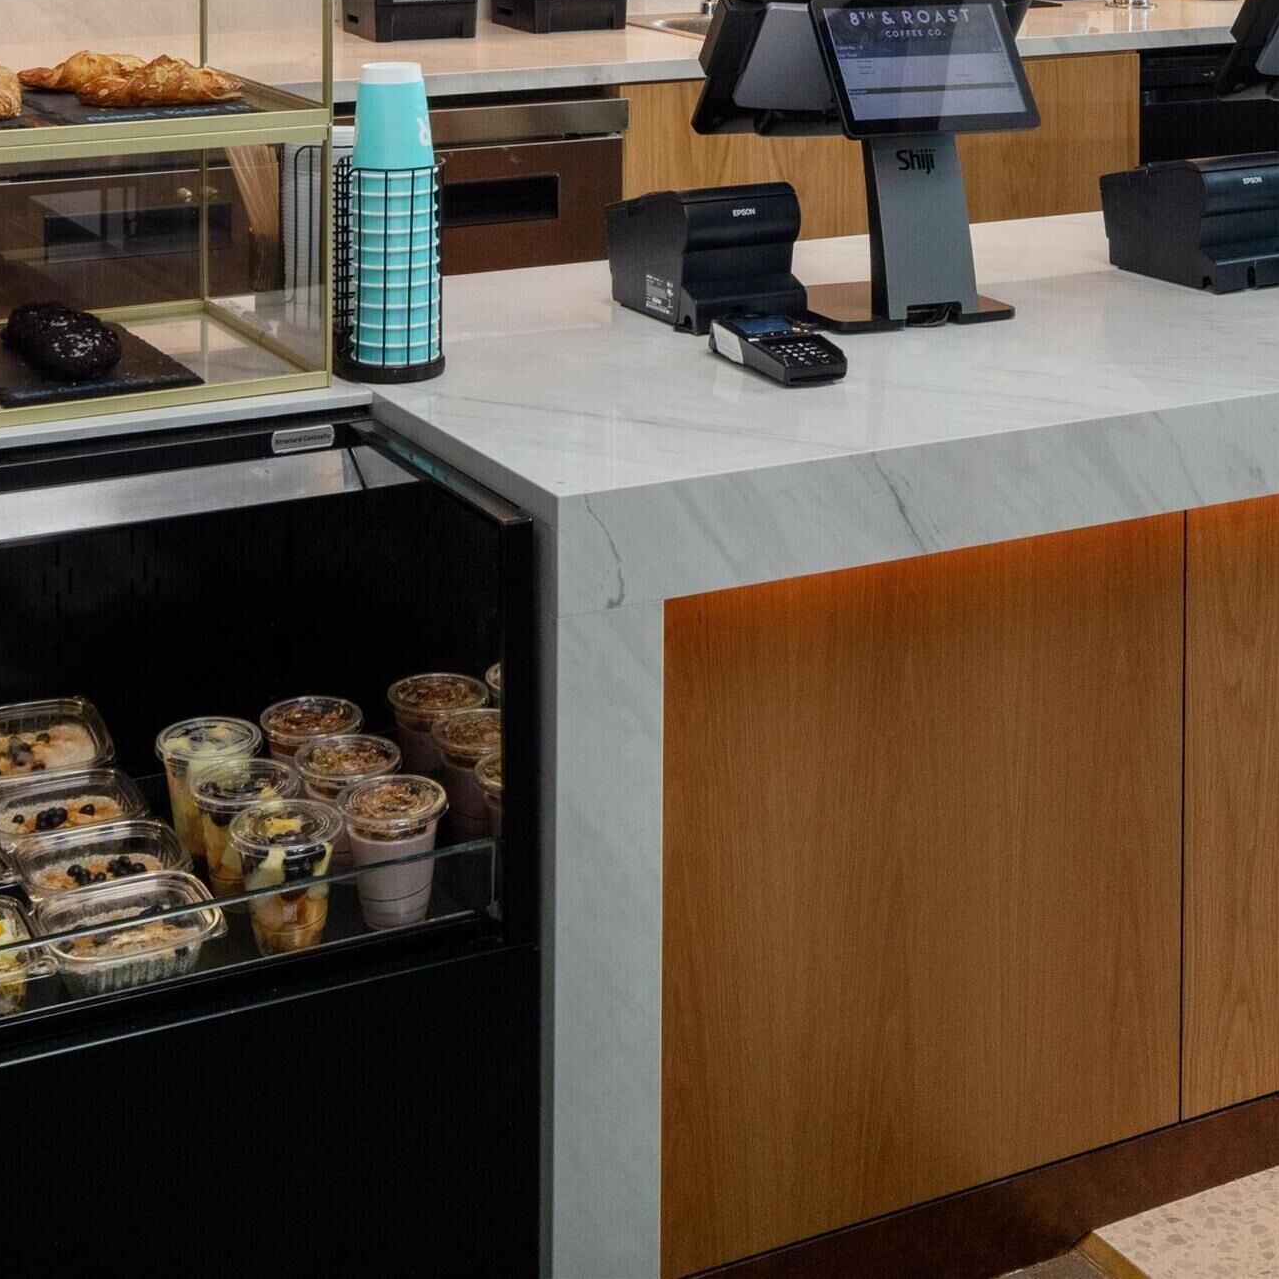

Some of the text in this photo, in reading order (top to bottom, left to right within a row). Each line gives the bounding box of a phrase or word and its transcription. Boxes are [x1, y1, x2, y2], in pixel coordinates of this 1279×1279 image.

[882, 10, 895, 25] &
[901, 9, 969, 24] ROAST
[885, 28, 924, 38] COFFEE
[1242, 177, 1263, 185] EPSON
[732, 208, 756, 217] EPSON
